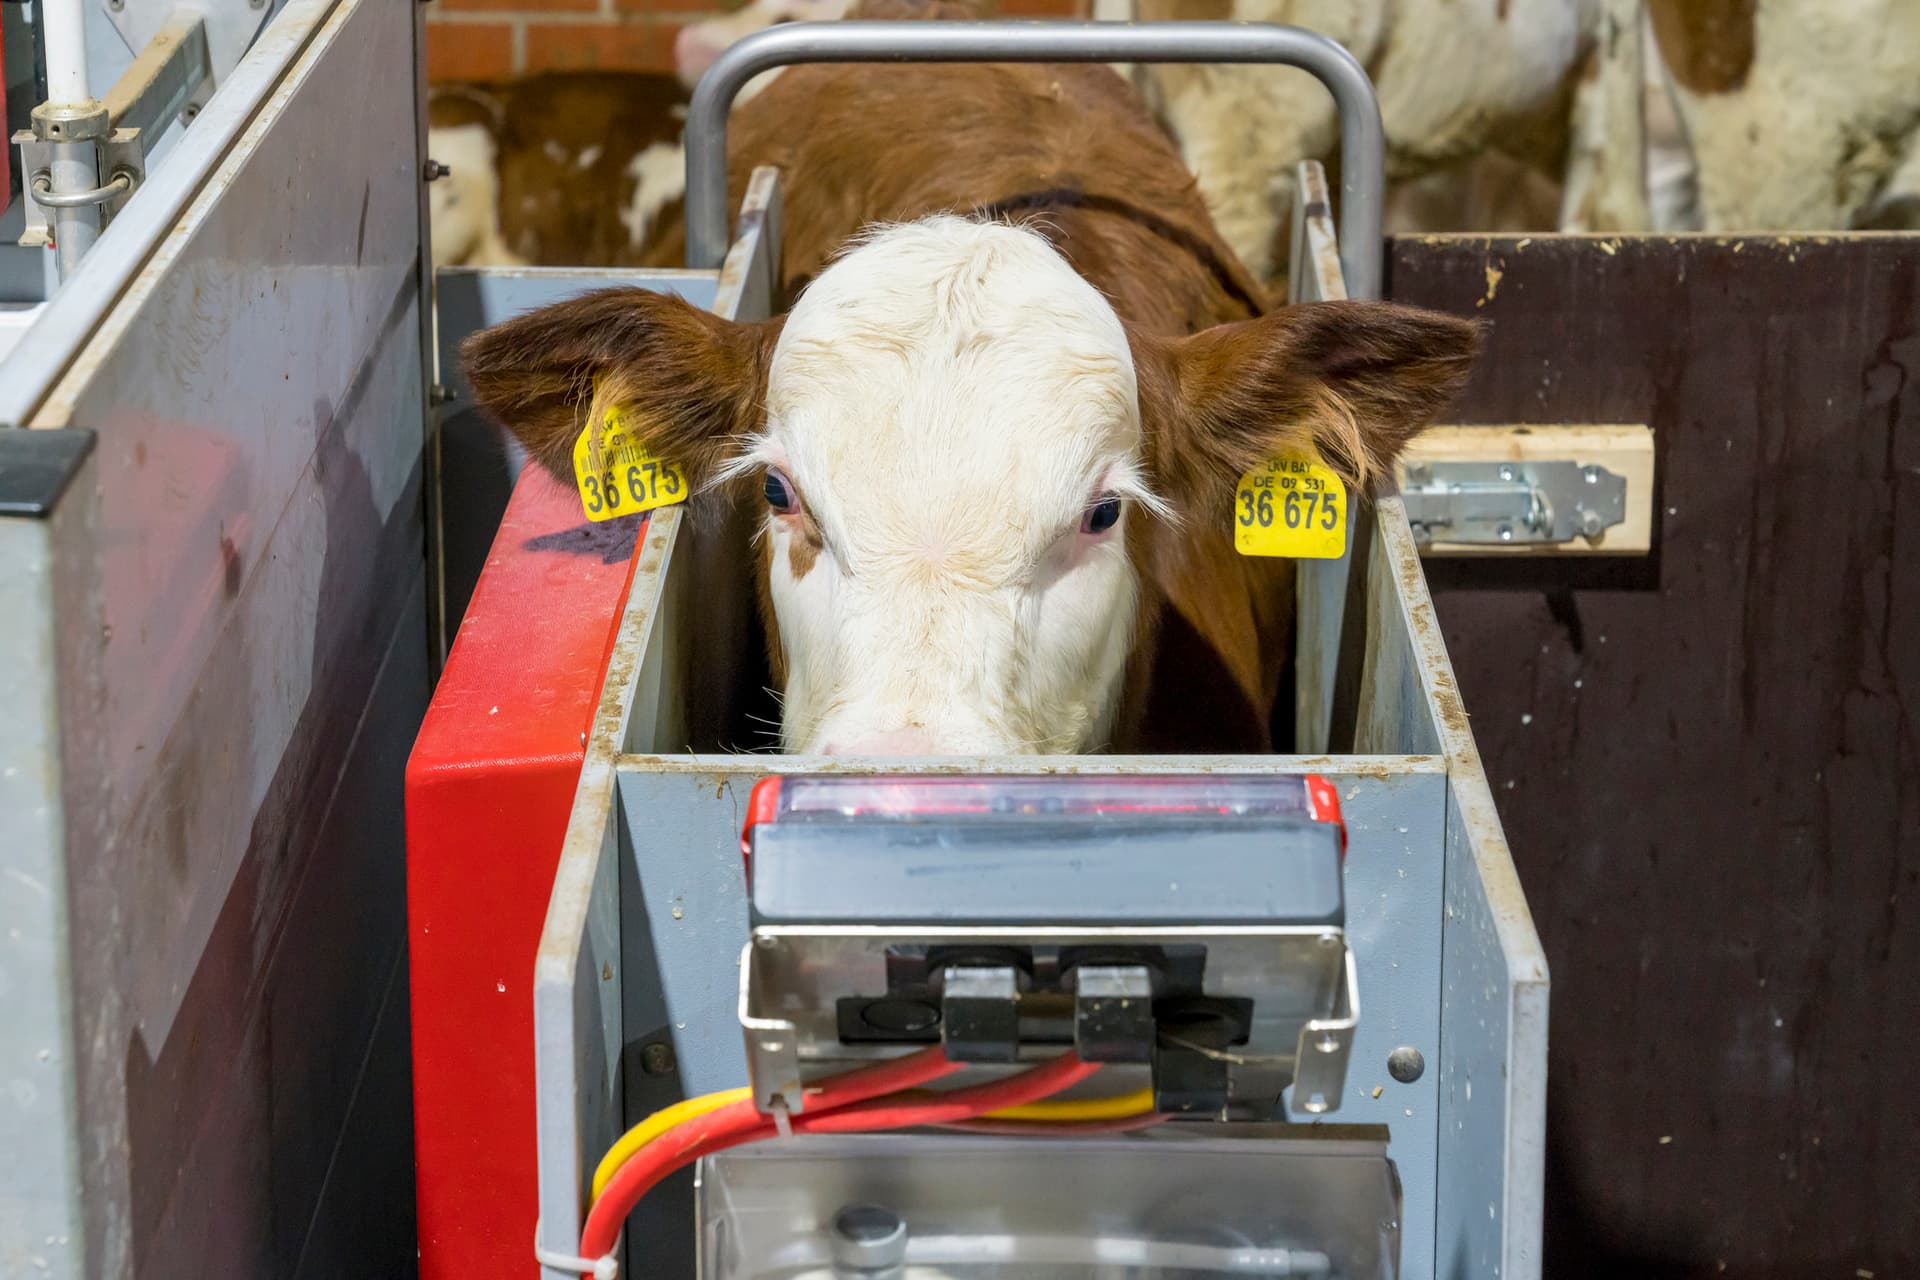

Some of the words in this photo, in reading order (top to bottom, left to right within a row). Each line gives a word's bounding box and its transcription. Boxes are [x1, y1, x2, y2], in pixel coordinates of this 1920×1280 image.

[1291, 461, 1312, 473] BAY
[584, 472, 620, 513] 36
[627, 462, 680, 503] 675
[1254, 476, 1275, 488] DE
[1282, 477, 1297, 489] 09
[1305, 478, 1325, 490] 531
[1239, 489, 1274, 528] 36
[1285, 491, 1338, 530] 675
